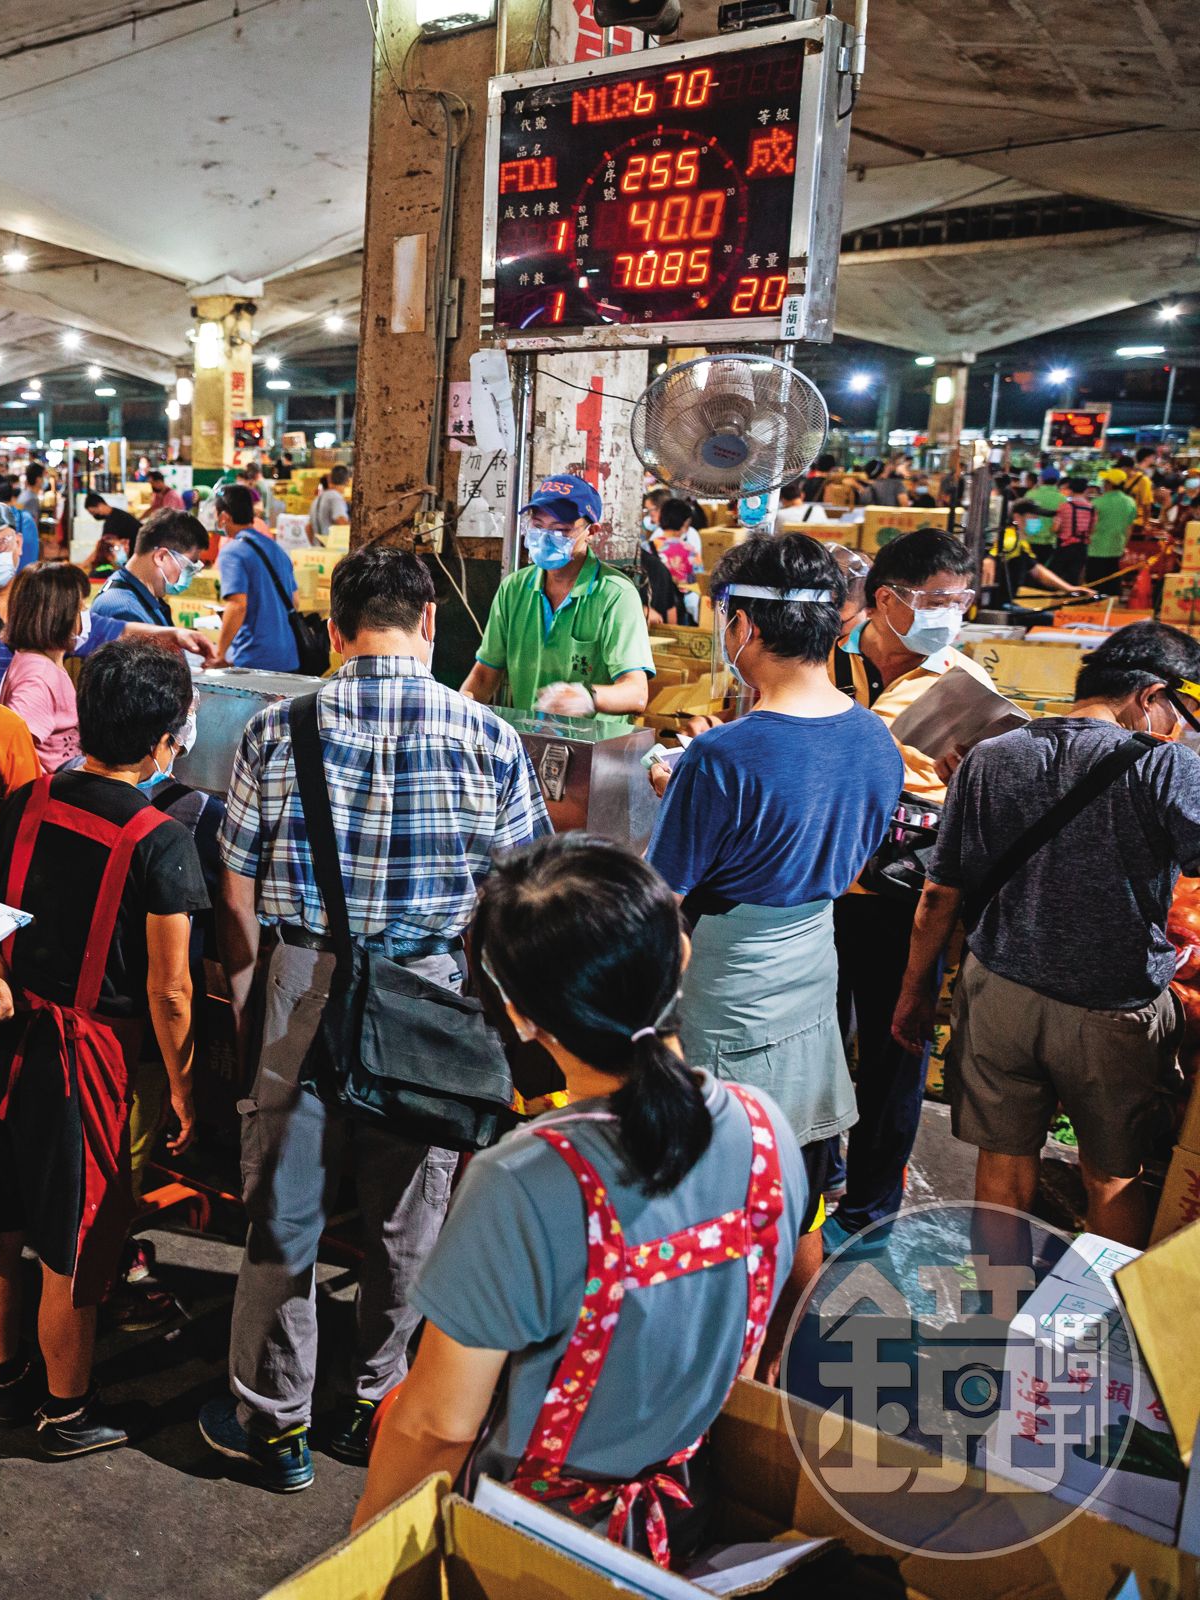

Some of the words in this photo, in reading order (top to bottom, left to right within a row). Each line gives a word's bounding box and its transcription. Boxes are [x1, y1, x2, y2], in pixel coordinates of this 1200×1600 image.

[520, 116, 548, 132] 代號
[757, 108, 791, 124] 等級
[516, 143, 542, 158] 品名
[745, 127, 795, 176] 成
[622, 149, 700, 192] 255
[603, 170, 617, 201] 序號
[726, 187, 735, 197] 20
[504, 201, 561, 219] 成交件數
[556, 221, 567, 251] 1
[577, 215, 590, 247] 單價
[723, 244, 732, 253] 30
[616, 247, 712, 288] 7085
[747, 252, 780, 270] 重量
[518, 272, 546, 286] 件數
[692, 291, 701, 300] 40
[731, 276, 787, 314] 20
[553, 292, 565, 323] 1
[784, 300, 799, 338] 花胡瓜
